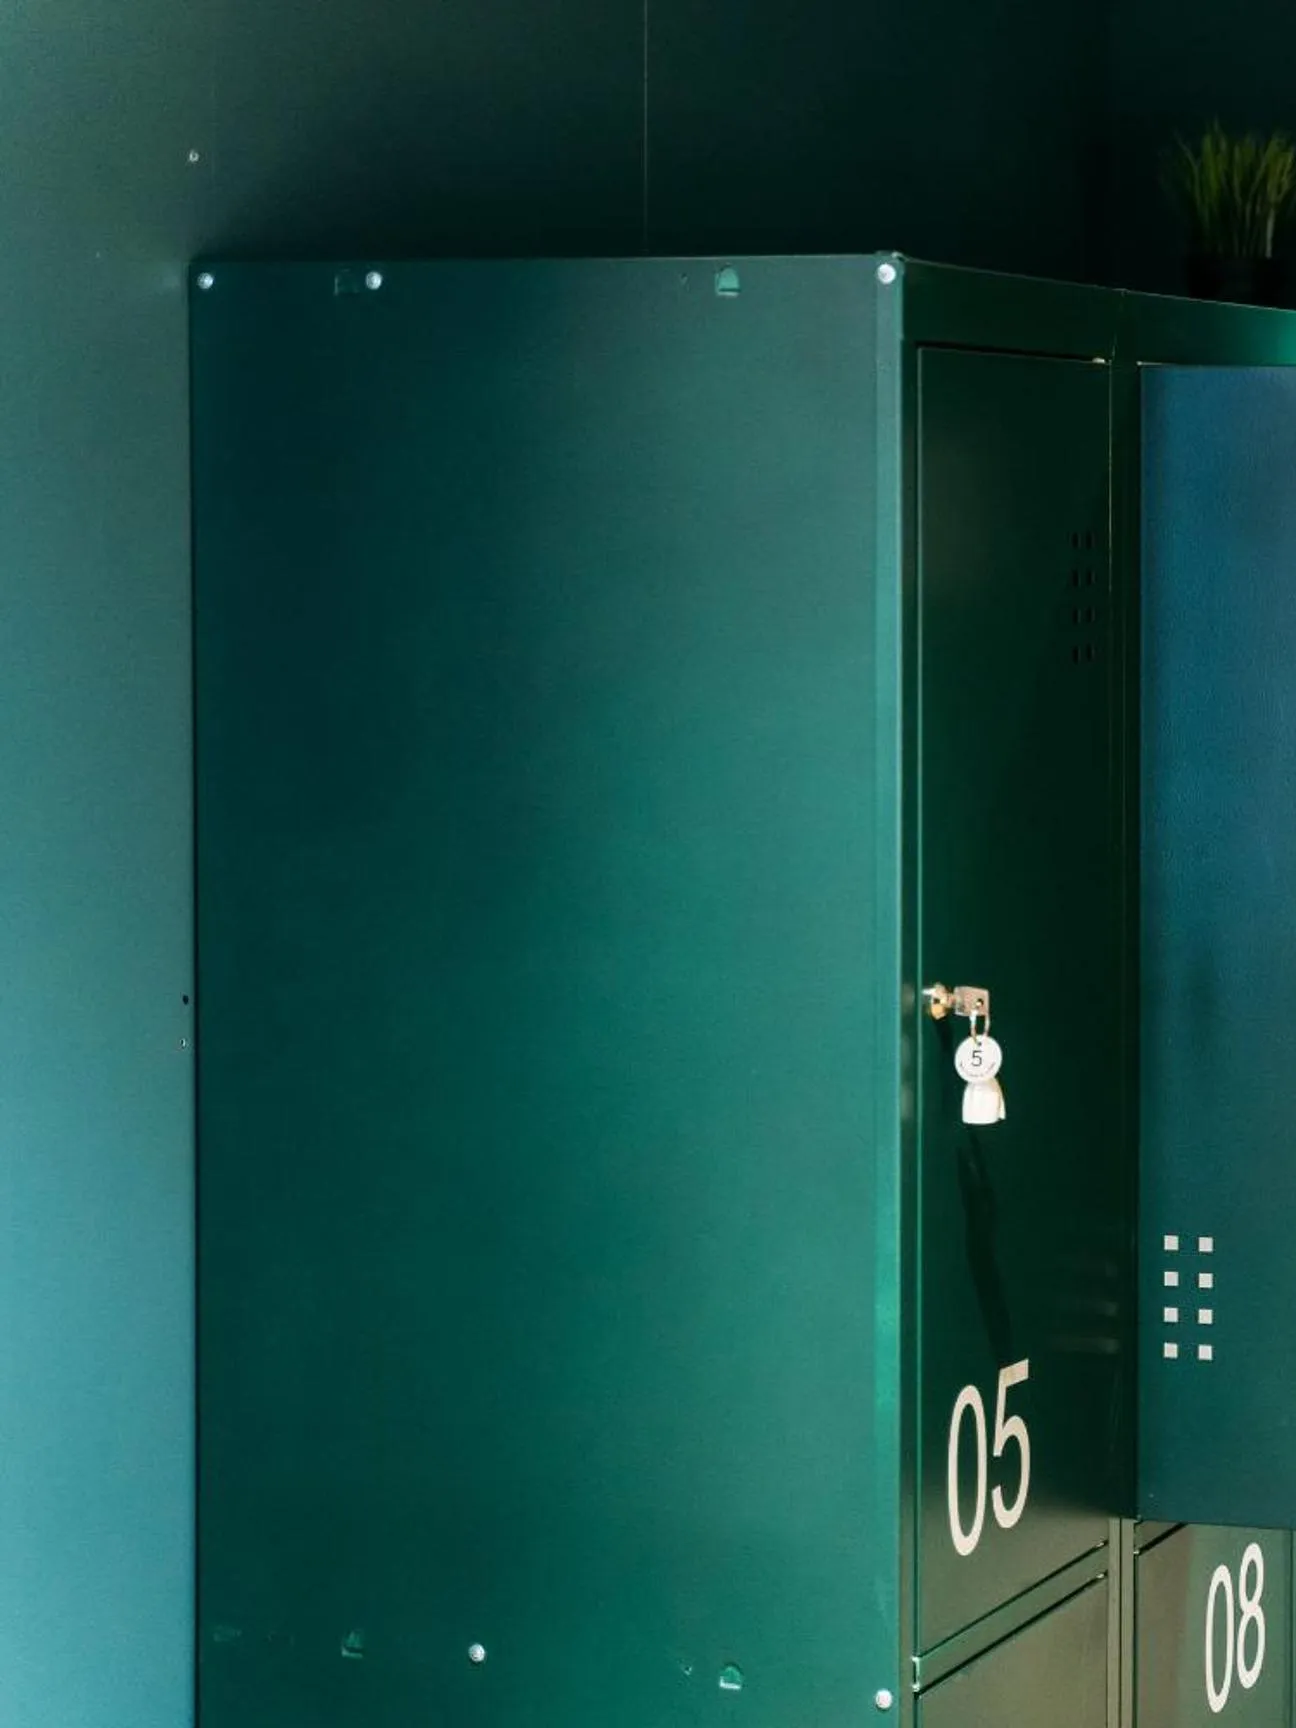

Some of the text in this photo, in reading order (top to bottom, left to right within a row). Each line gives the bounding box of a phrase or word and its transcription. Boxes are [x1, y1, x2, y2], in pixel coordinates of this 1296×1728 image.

[971, 1050, 983, 1067] 5
[948, 1358, 1031, 1556] 05
[1206, 1543, 1266, 1713] 08
